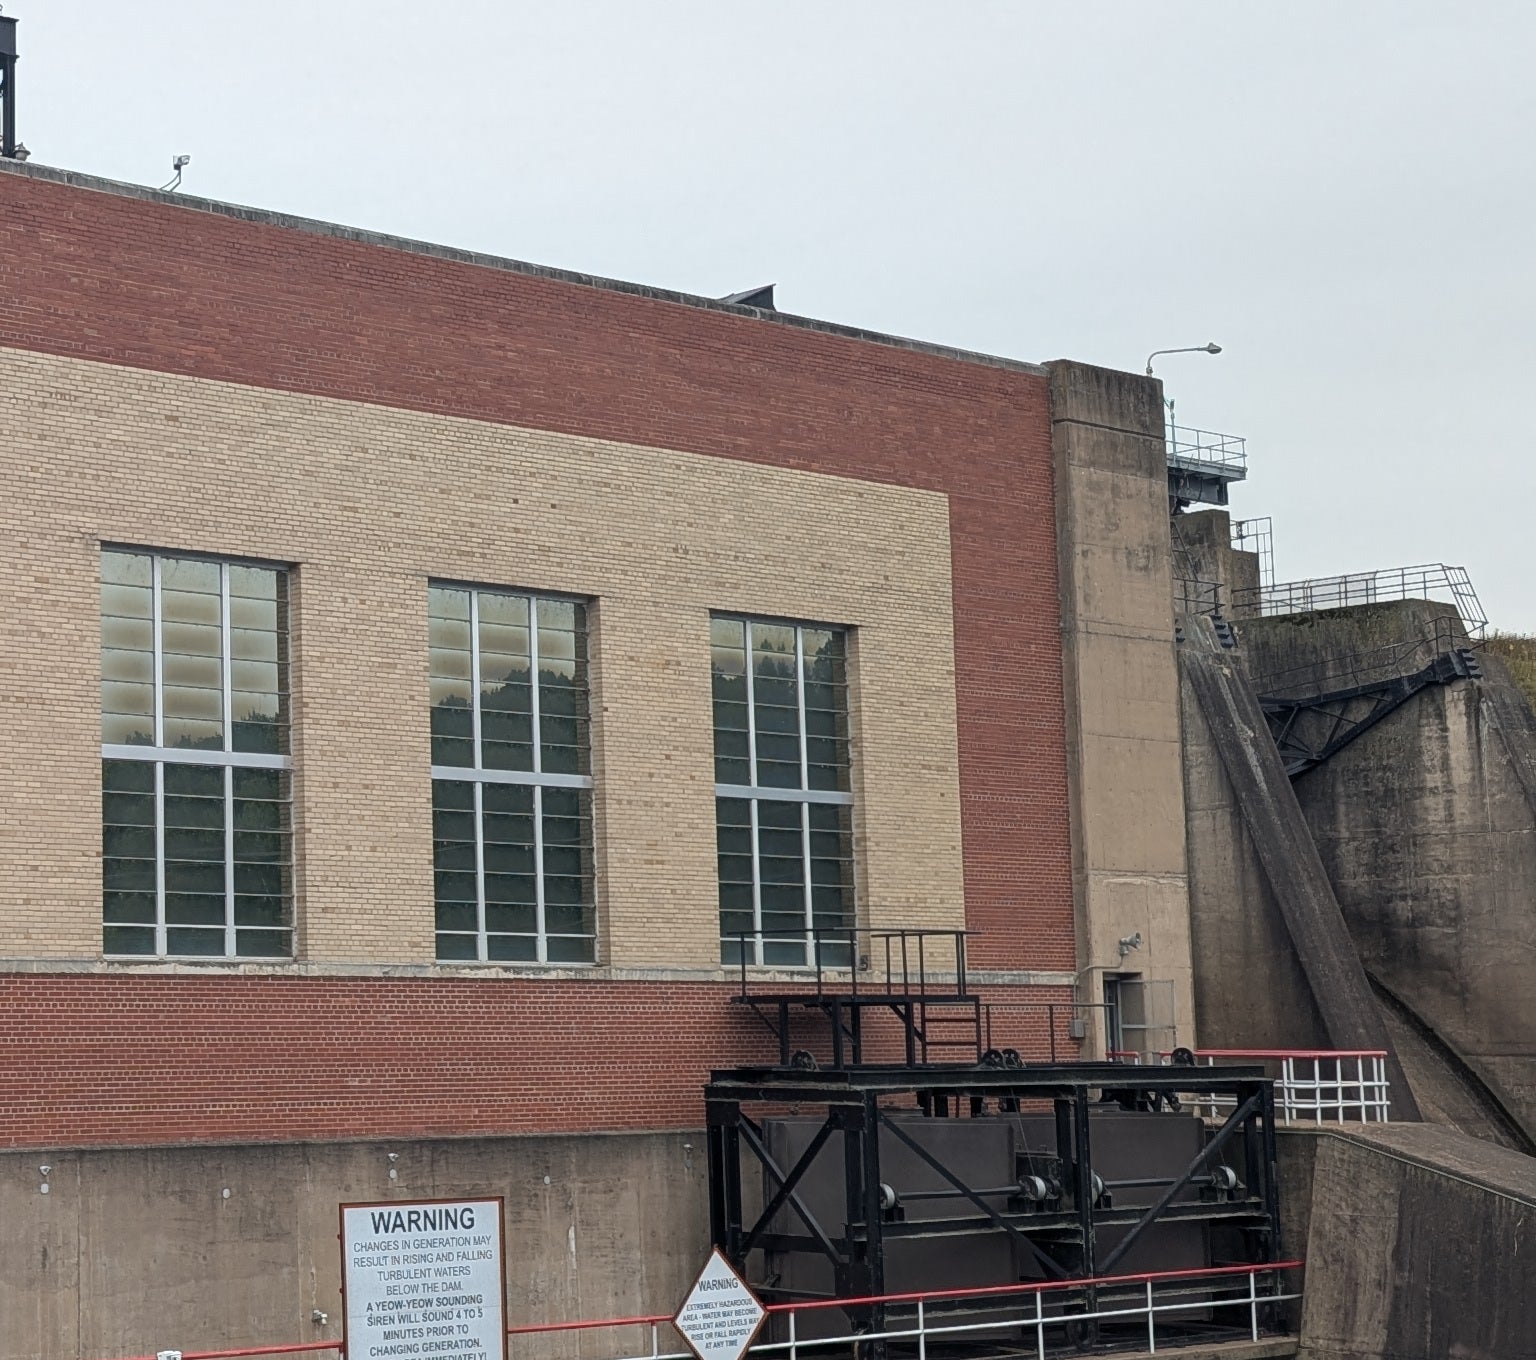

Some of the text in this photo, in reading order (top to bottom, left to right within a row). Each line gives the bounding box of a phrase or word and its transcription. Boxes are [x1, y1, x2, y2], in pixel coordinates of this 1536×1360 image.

[371, 1208, 475, 1234] WARNING
[354, 1235, 492, 1252] CHANGES IN GENERATION MAY
[353, 1249, 493, 1267] RESULT IN RISING AND FALLING
[378, 1266, 471, 1281] TURBULENT WATERS
[386, 1281, 463, 1296] BELOW THE DAM.
[698, 1278, 739, 1292] WARNING
[366, 1294, 483, 1312] A YEOW-YEOW SOUNDING
[687, 1298, 752, 1311] EXTREMELY HAZARDOUS
[367, 1307, 483, 1327] SIREN WILL SOUND 4 TO 5
[683, 1314, 698, 1322] AREA
[702, 1311, 721, 1320] WATER
[722, 1310, 733, 1318] MAY
[734, 1308, 757, 1316] BECOME
[384, 1324, 469, 1340] MINUTES PRIOR TO
[682, 1322, 713, 1331] TURBULENT
[715, 1320, 726, 1328] AND
[727, 1319, 747, 1327] LEVELS
[729, 1328, 751, 1337] RAPIDLY
[370, 1338, 482, 1357] CHANGING GENERATION.
